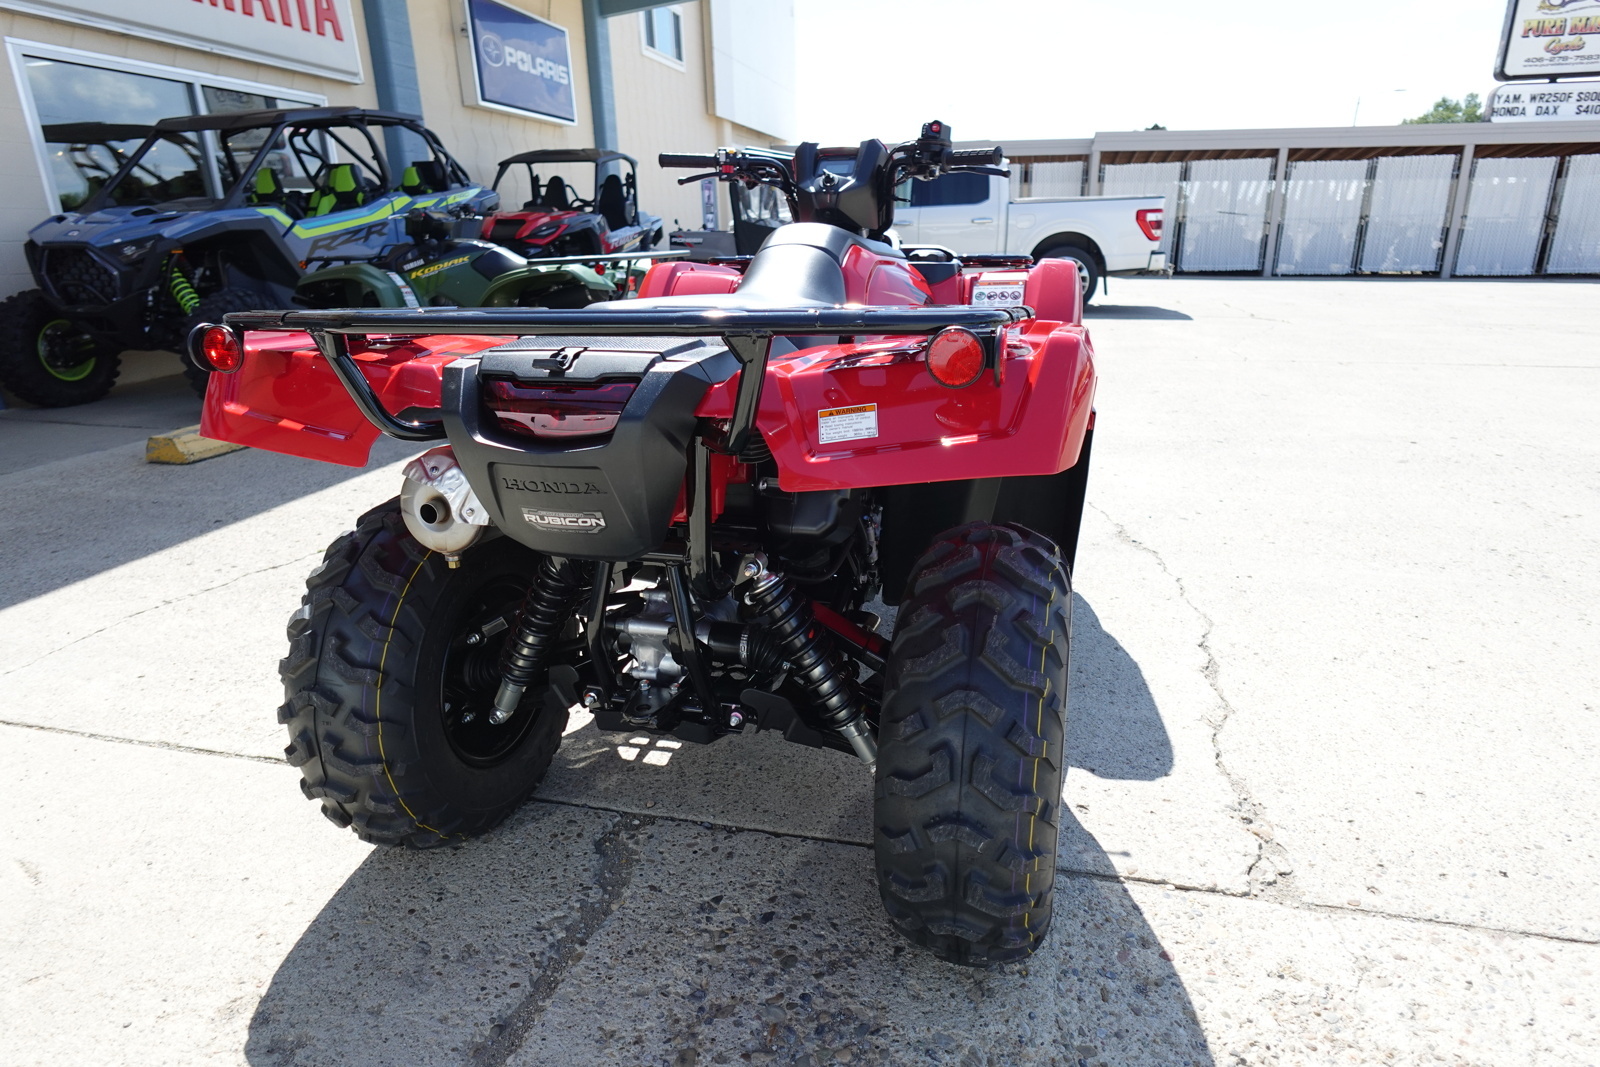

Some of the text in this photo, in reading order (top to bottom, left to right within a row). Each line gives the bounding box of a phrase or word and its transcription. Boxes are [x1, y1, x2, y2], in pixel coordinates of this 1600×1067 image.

[1521, 18, 1567, 38] PURE
[504, 45, 569, 85] POLARIS
[1530, 92, 1573, 103] WR250F
[1491, 107, 1526, 117] HONDA
[1535, 105, 1560, 116] DAX
[307, 221, 389, 257] RZR
[835, 406, 867, 415] WARNING
[502, 477, 608, 495] HONDA
[523, 513, 606, 527] RUBICON
